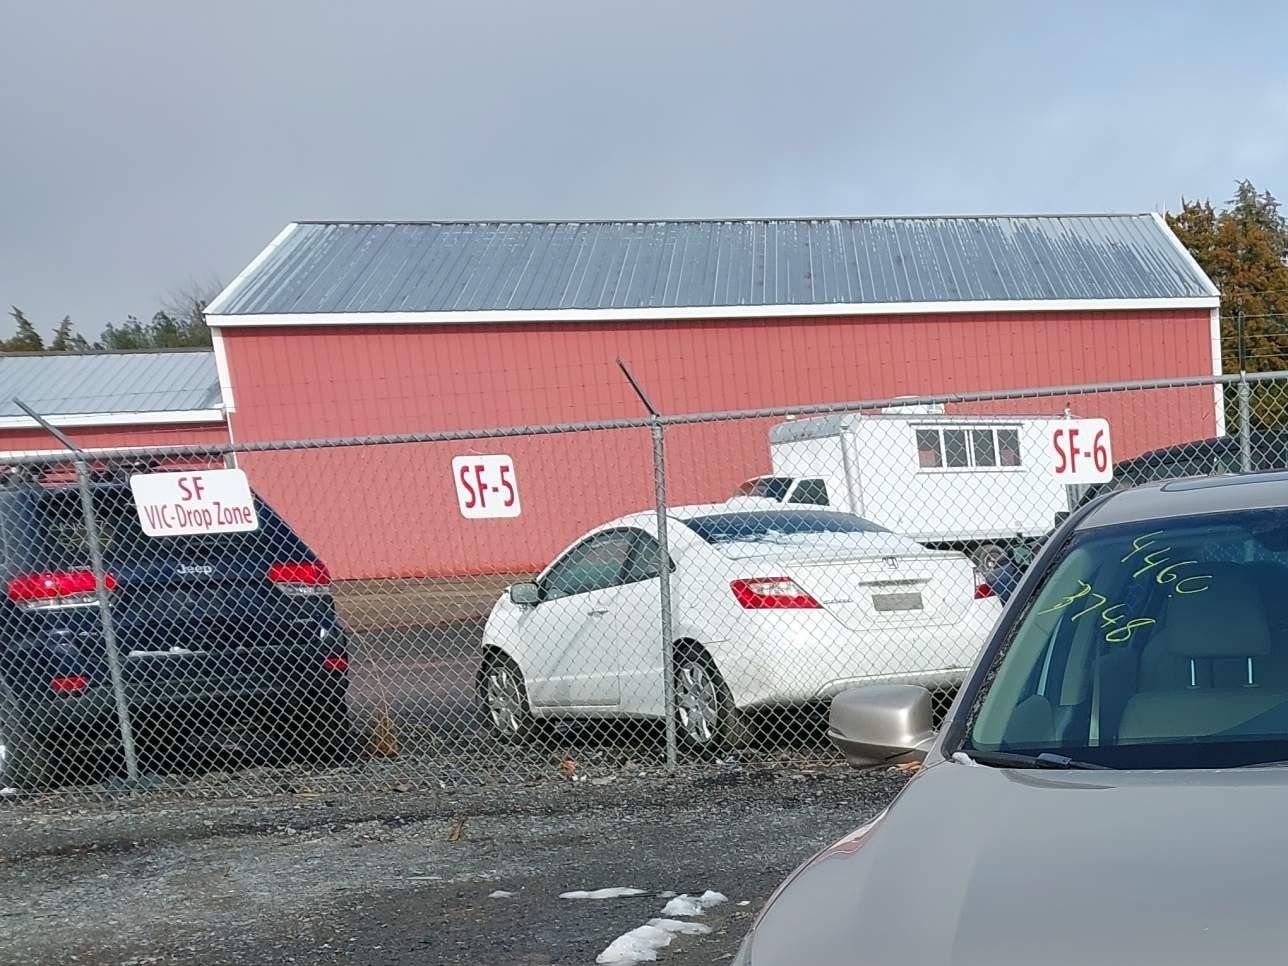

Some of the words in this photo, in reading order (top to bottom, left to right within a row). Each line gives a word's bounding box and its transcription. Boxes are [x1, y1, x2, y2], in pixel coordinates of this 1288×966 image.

[1053, 428, 1107, 473] SF-6
[178, 476, 205, 501] SF
[460, 465, 514, 508] SF-5
[143, 503, 213, 530] VIC-Drop
[212, 501, 253, 525] Zone
[176, 564, 213, 575] Jeep
